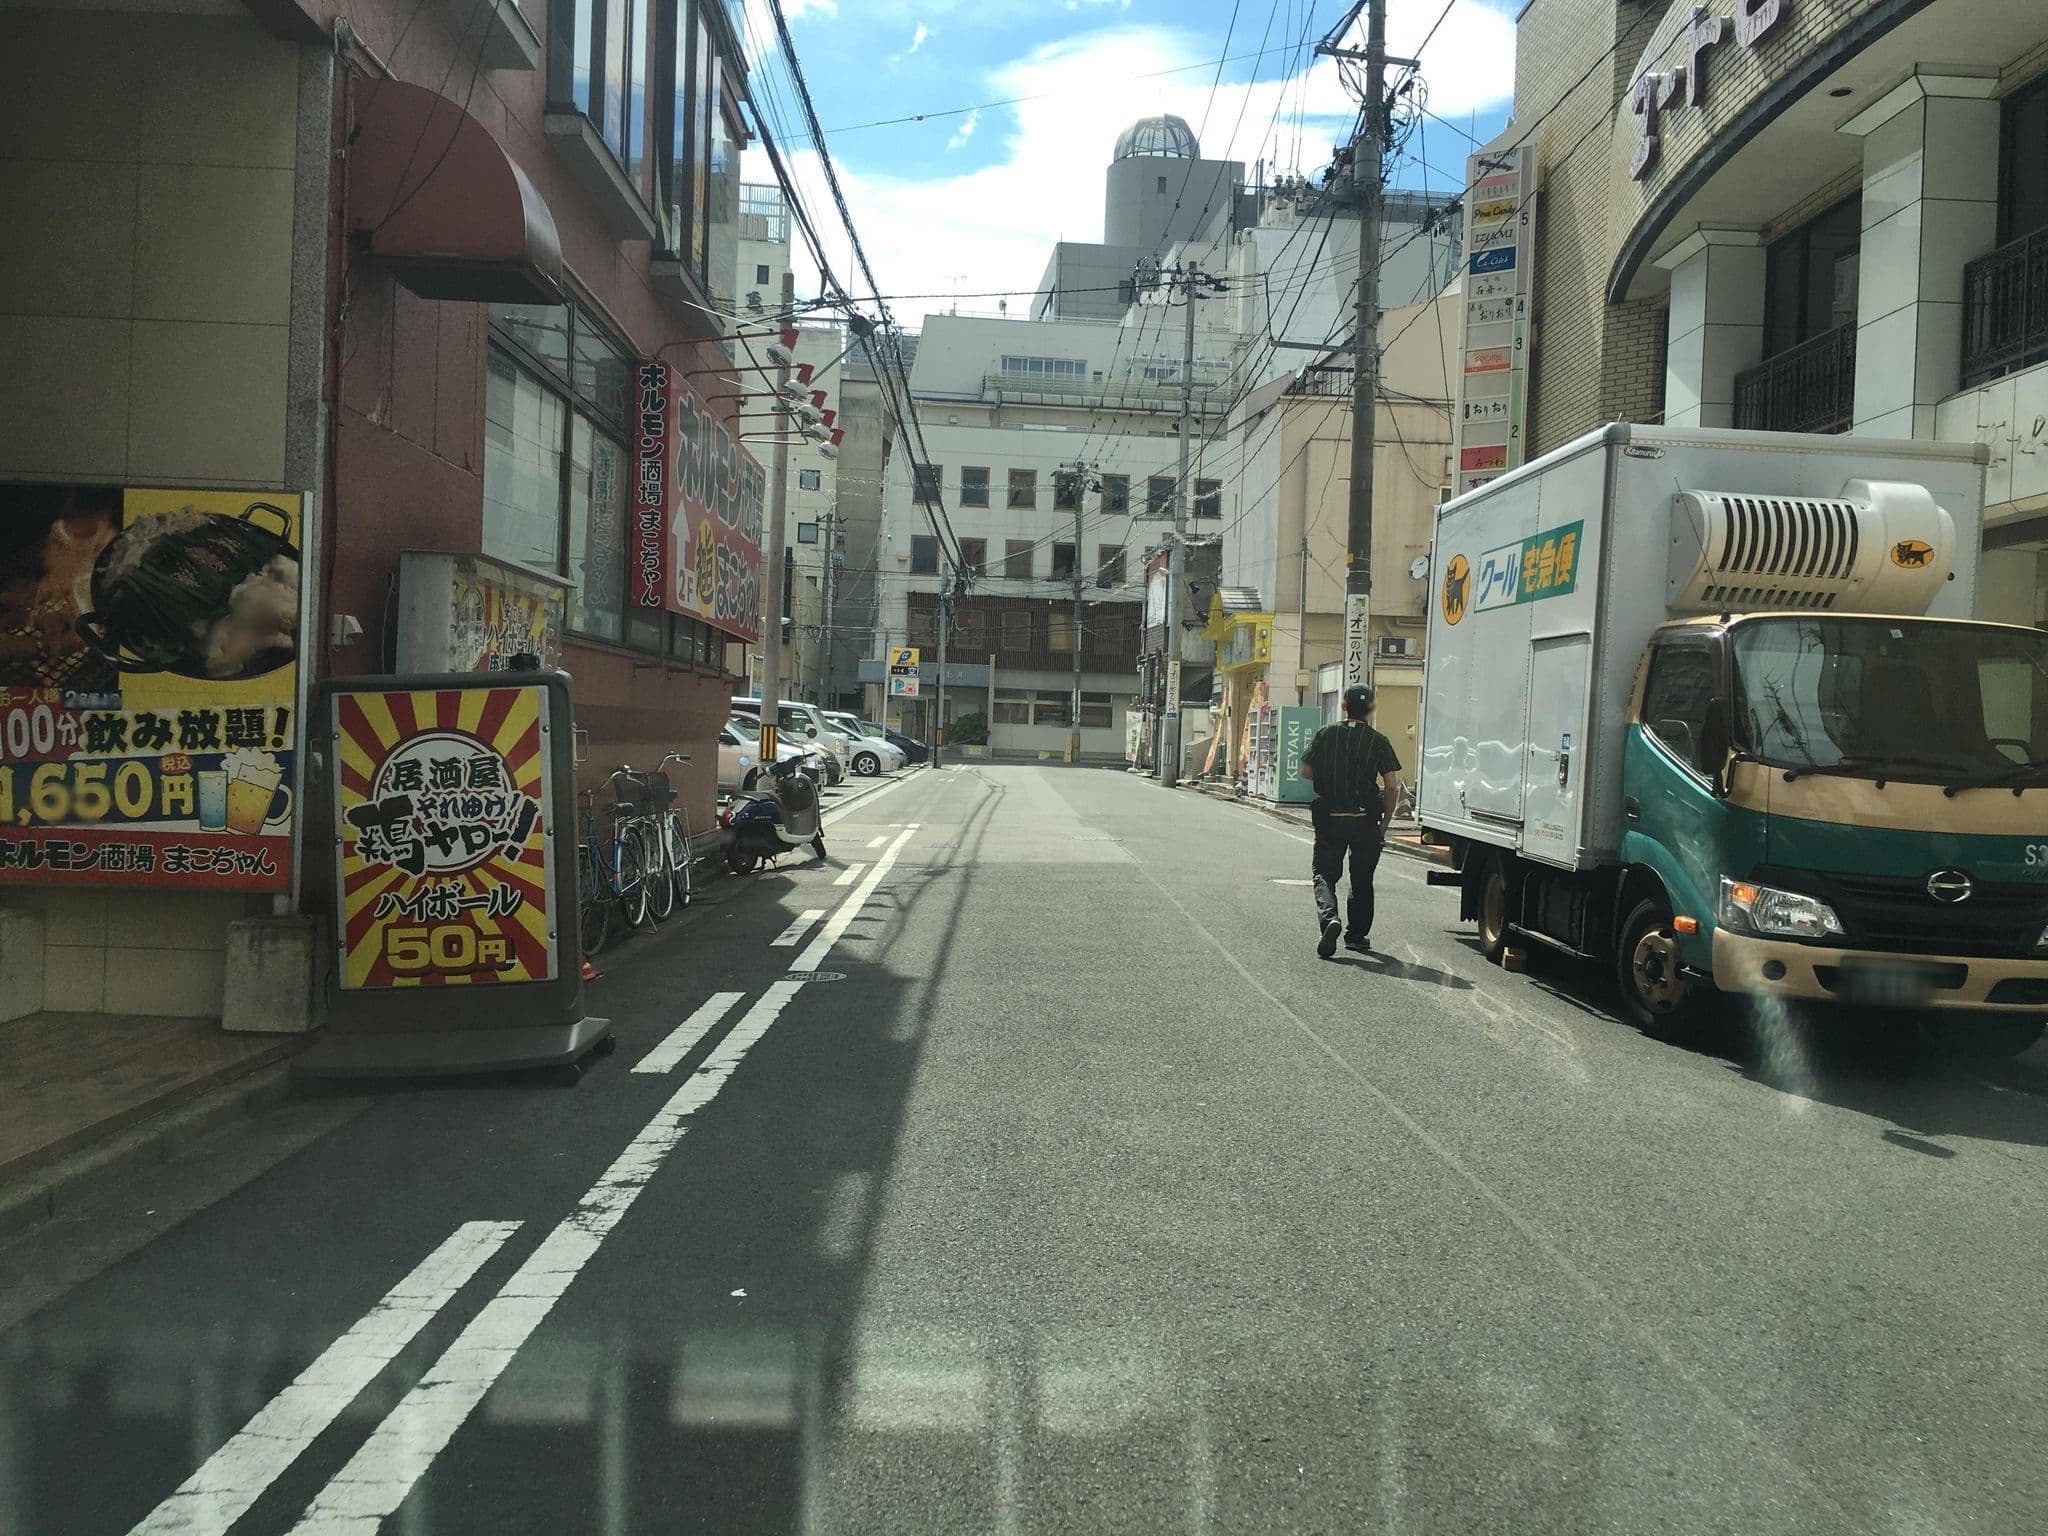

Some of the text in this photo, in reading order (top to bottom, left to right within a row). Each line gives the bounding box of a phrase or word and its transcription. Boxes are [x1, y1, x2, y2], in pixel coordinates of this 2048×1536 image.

[1521, 212, 1529, 226] 5
[1516, 300, 1524, 314] 4
[1515, 337, 1522, 350] 3
[1473, 402, 1508, 417] おりおり
[1511, 424, 1518, 438] 2
[638, 363, 667, 607] ホルモン酒場 まこちゃん
[679, 569, 693, 603] 2F
[0, 704, 78, 761] 00分
[1286, 720, 1300, 782] KEYAKI
[390, 752, 503, 792] 居酒屋
[162, 844, 278, 876] まこちゃん
[374, 882, 524, 922] ハイボール
[387, 924, 508, 971] 50円
